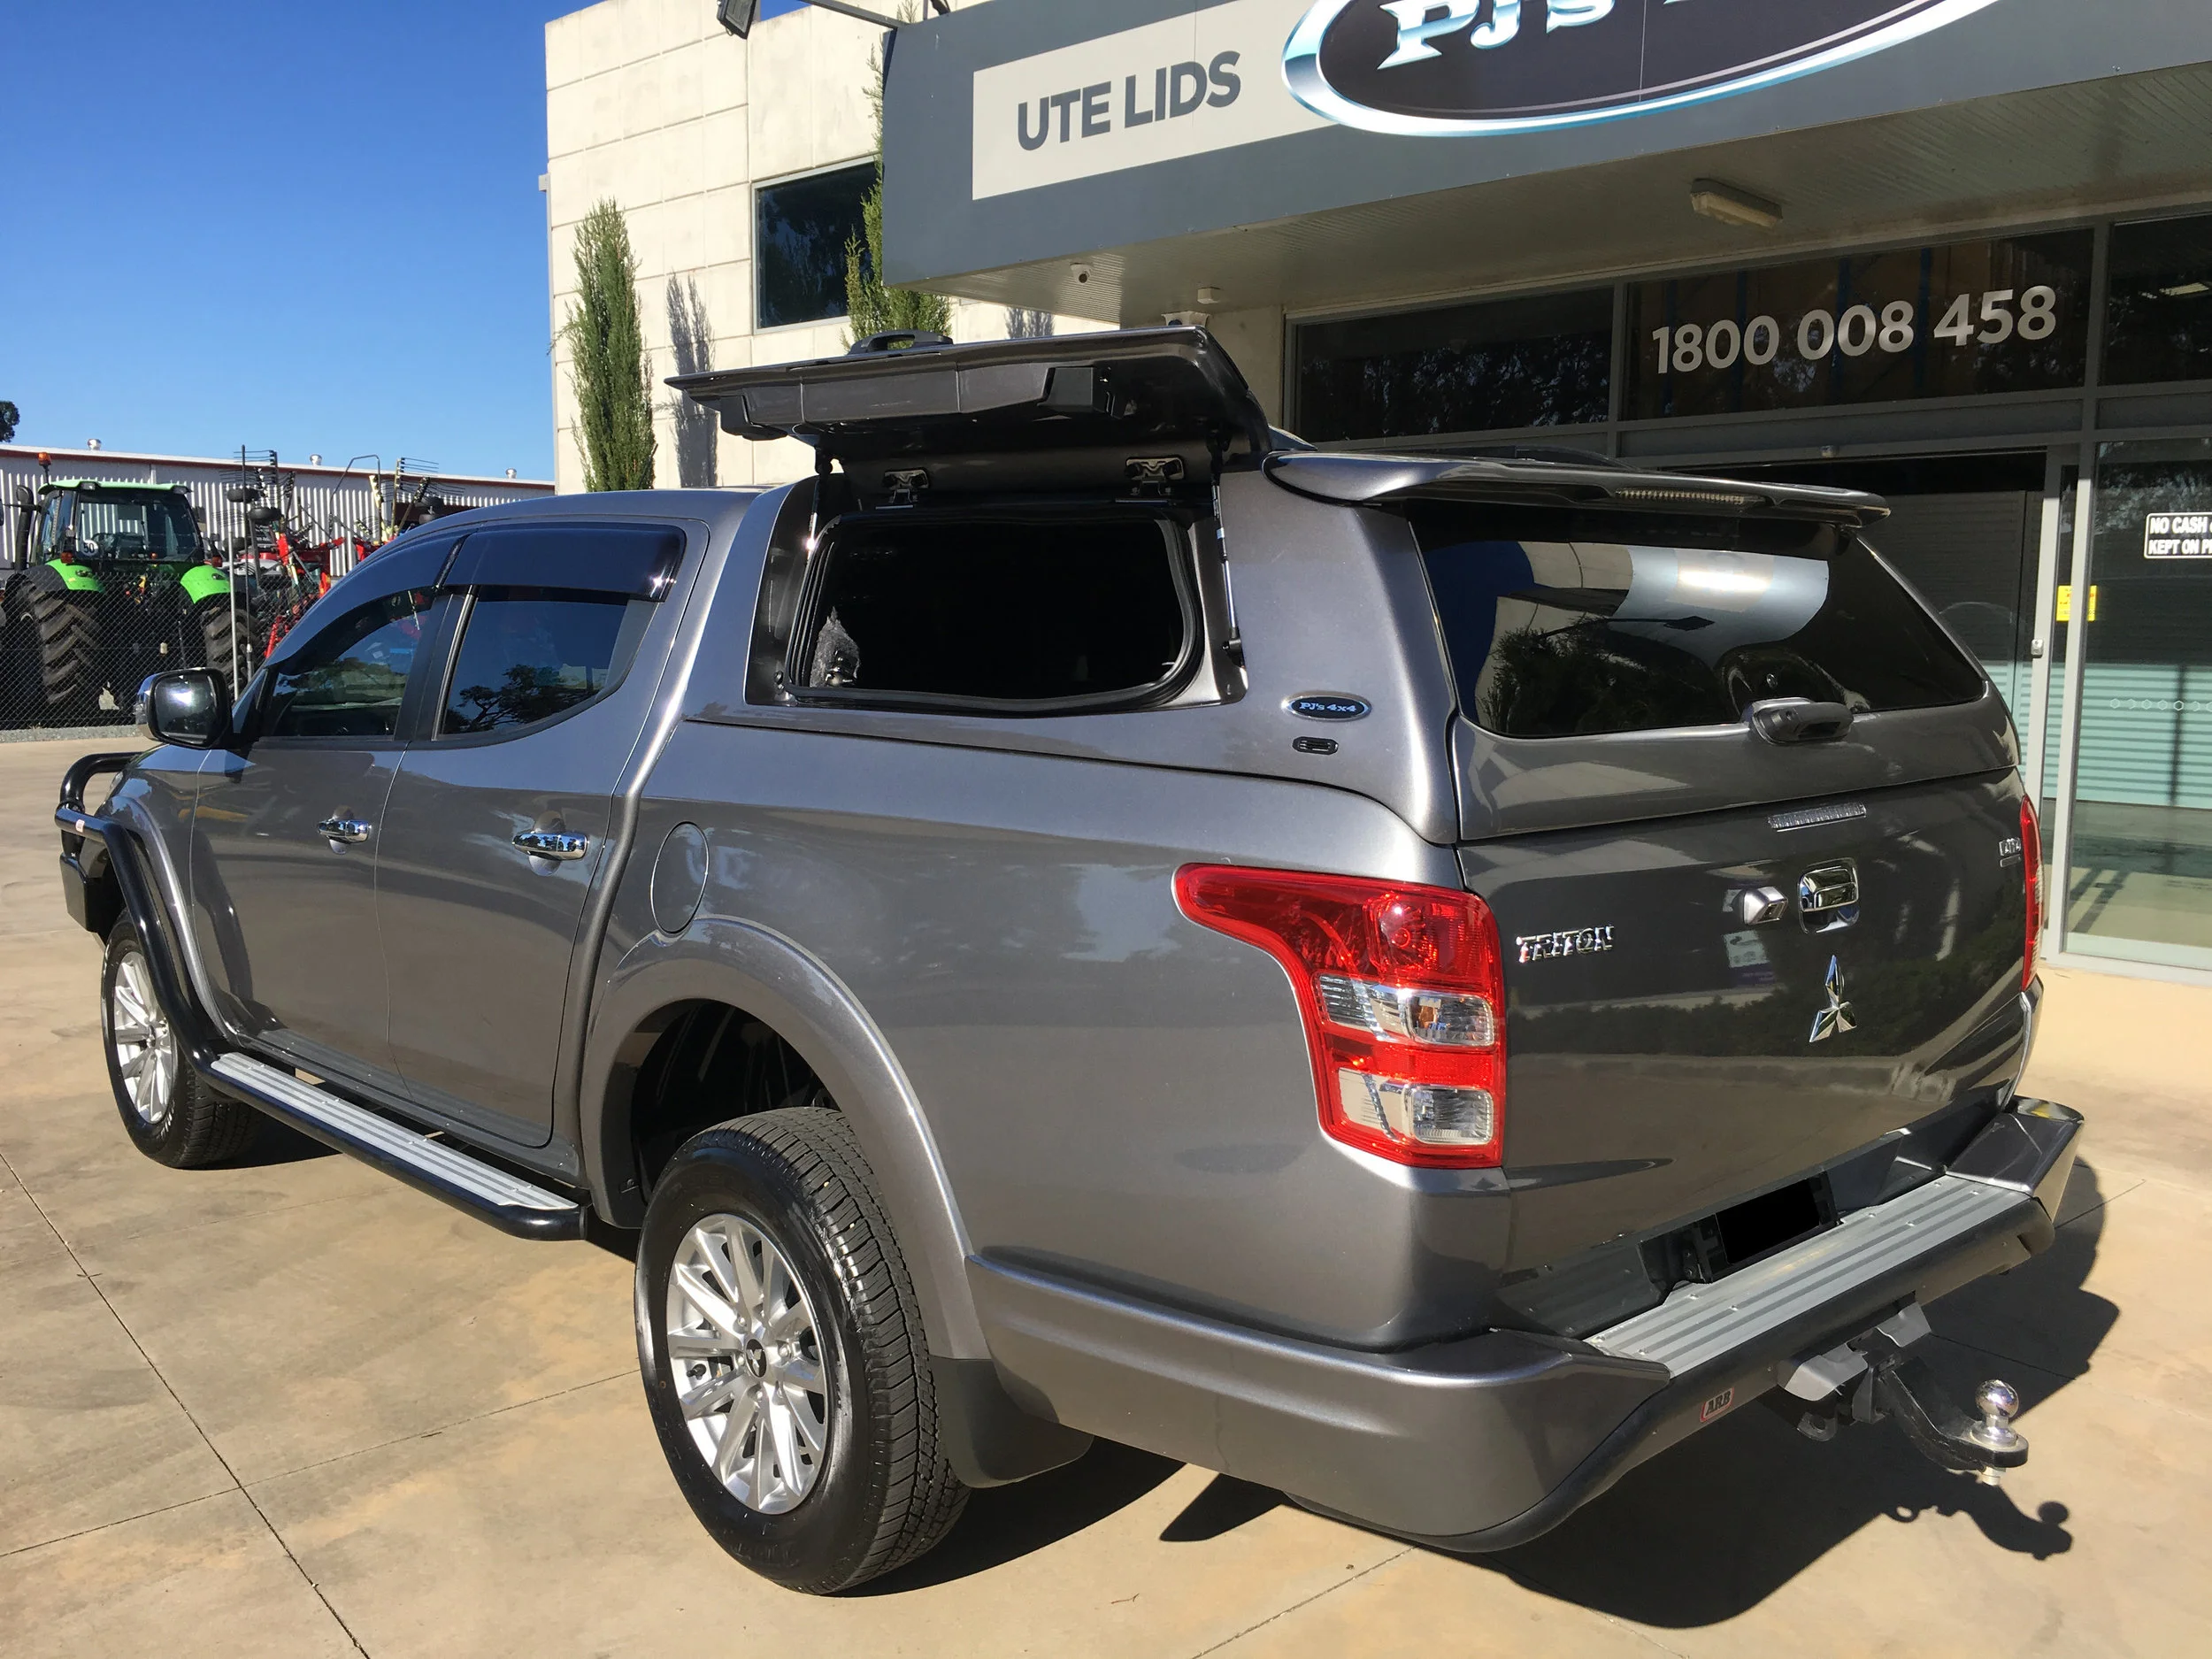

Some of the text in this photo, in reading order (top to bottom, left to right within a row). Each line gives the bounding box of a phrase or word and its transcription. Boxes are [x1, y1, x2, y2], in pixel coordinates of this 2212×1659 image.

[1018, 50, 1241, 151] UTE LIDS
[1651, 284, 2057, 374] 1800 008 458
[2149, 516, 2170, 534] NO
[2172, 516, 2208, 534] CASH
[83, 542, 96, 554] 50
[2147, 539, 2181, 555] KEPT
[2181, 538, 2200, 555] ON
[1299, 702, 1357, 712] PJ's 4x4
[1516, 926, 1615, 964] TRITON
[1704, 1390, 1732, 1417] ARB
